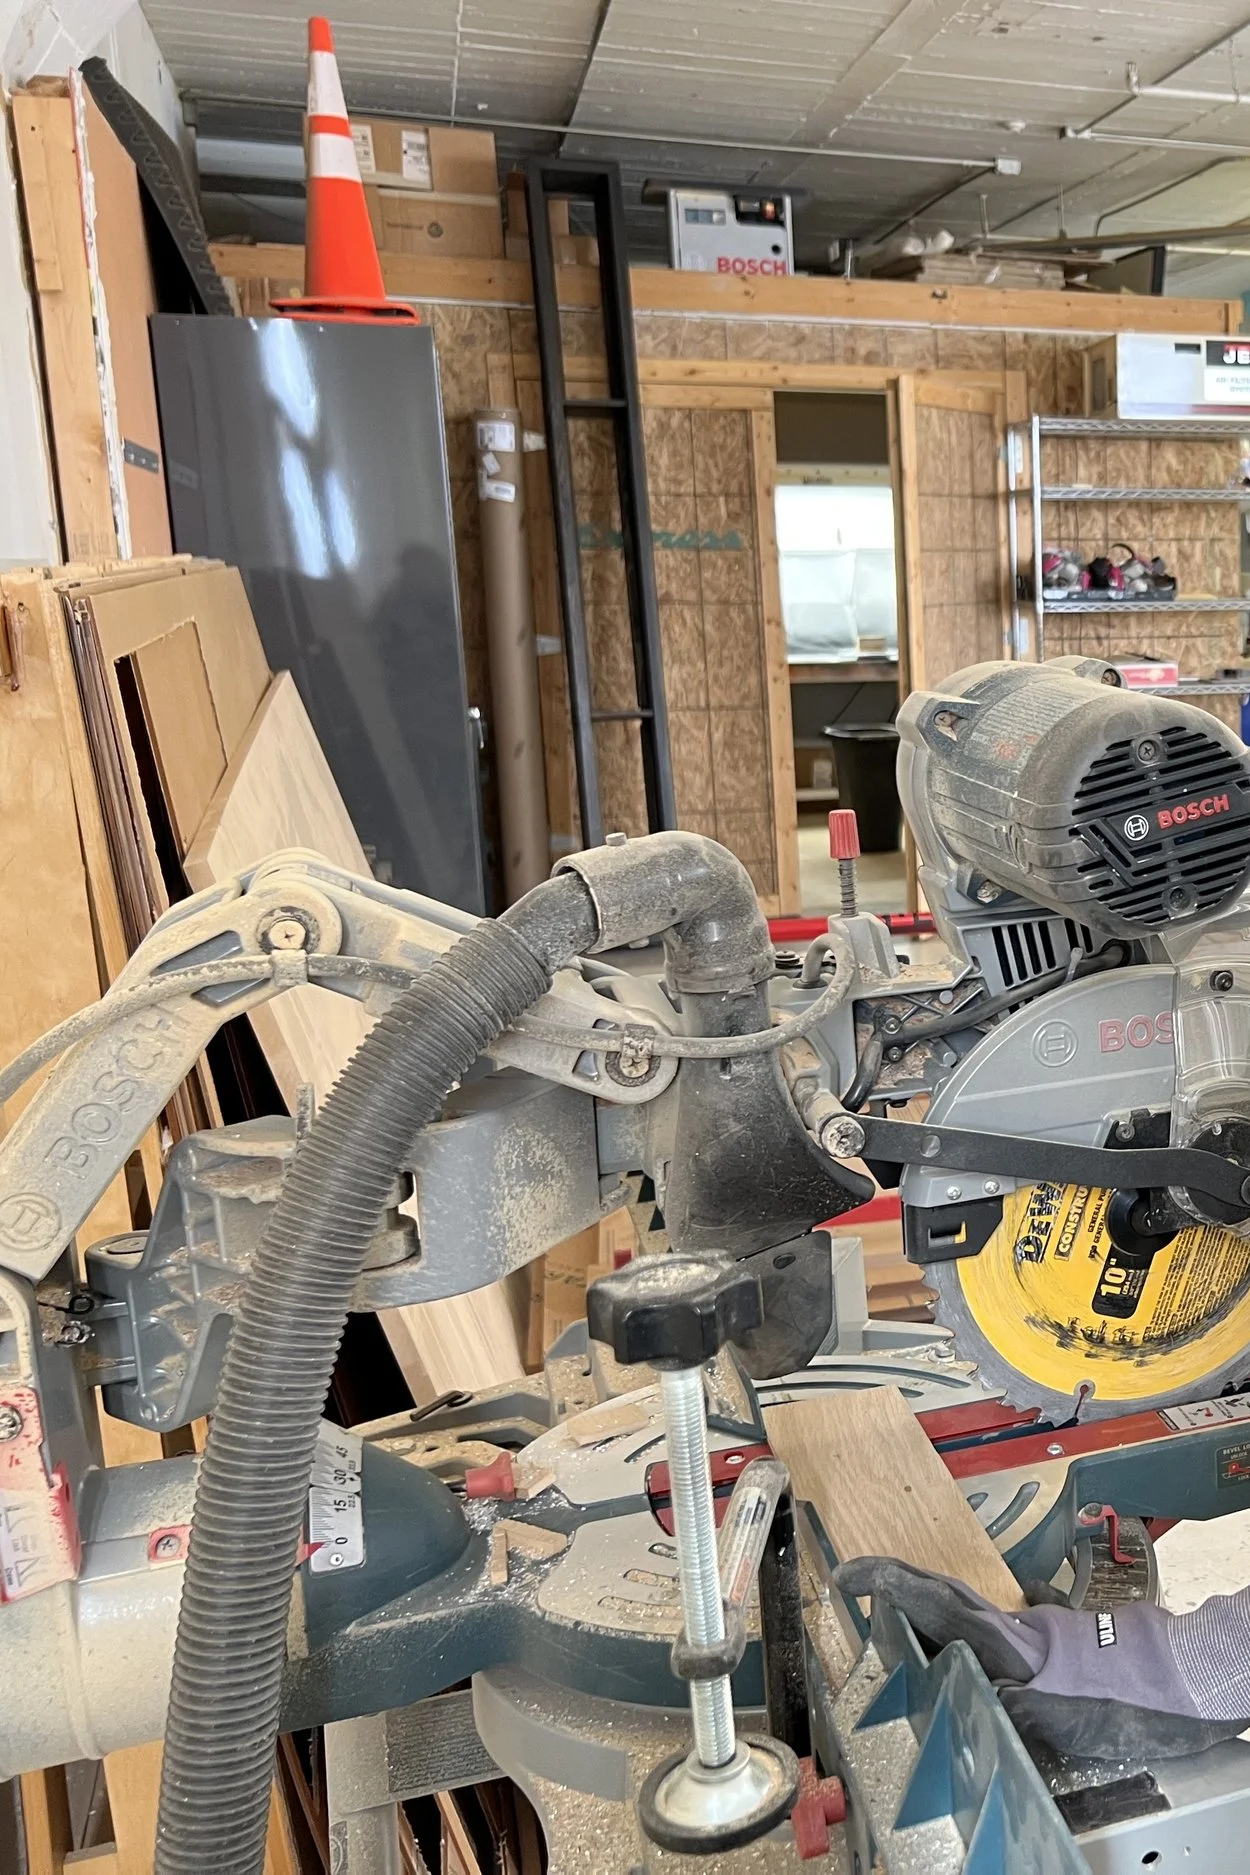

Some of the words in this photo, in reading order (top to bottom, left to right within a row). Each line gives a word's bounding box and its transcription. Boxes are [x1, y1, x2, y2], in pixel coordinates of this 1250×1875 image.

[717, 256, 787, 276] BOSCH
[1157, 793, 1230, 829] BOSCH
[1098, 1011, 1174, 1053] BOS
[43, 1003, 193, 1181] BOSCH
[1016, 1182, 1065, 1263] DEW
[1058, 1185, 1089, 1253] CONSTRU
[336, 1445, 348, 1458] 45
[1223, 1447, 1240, 1455] BEVEL
[334, 1469, 347, 1485] 30
[334, 1500, 347, 1512] 15
[335, 1537, 348, 1545] 0
[1098, 1613, 1115, 1646] ULINE
